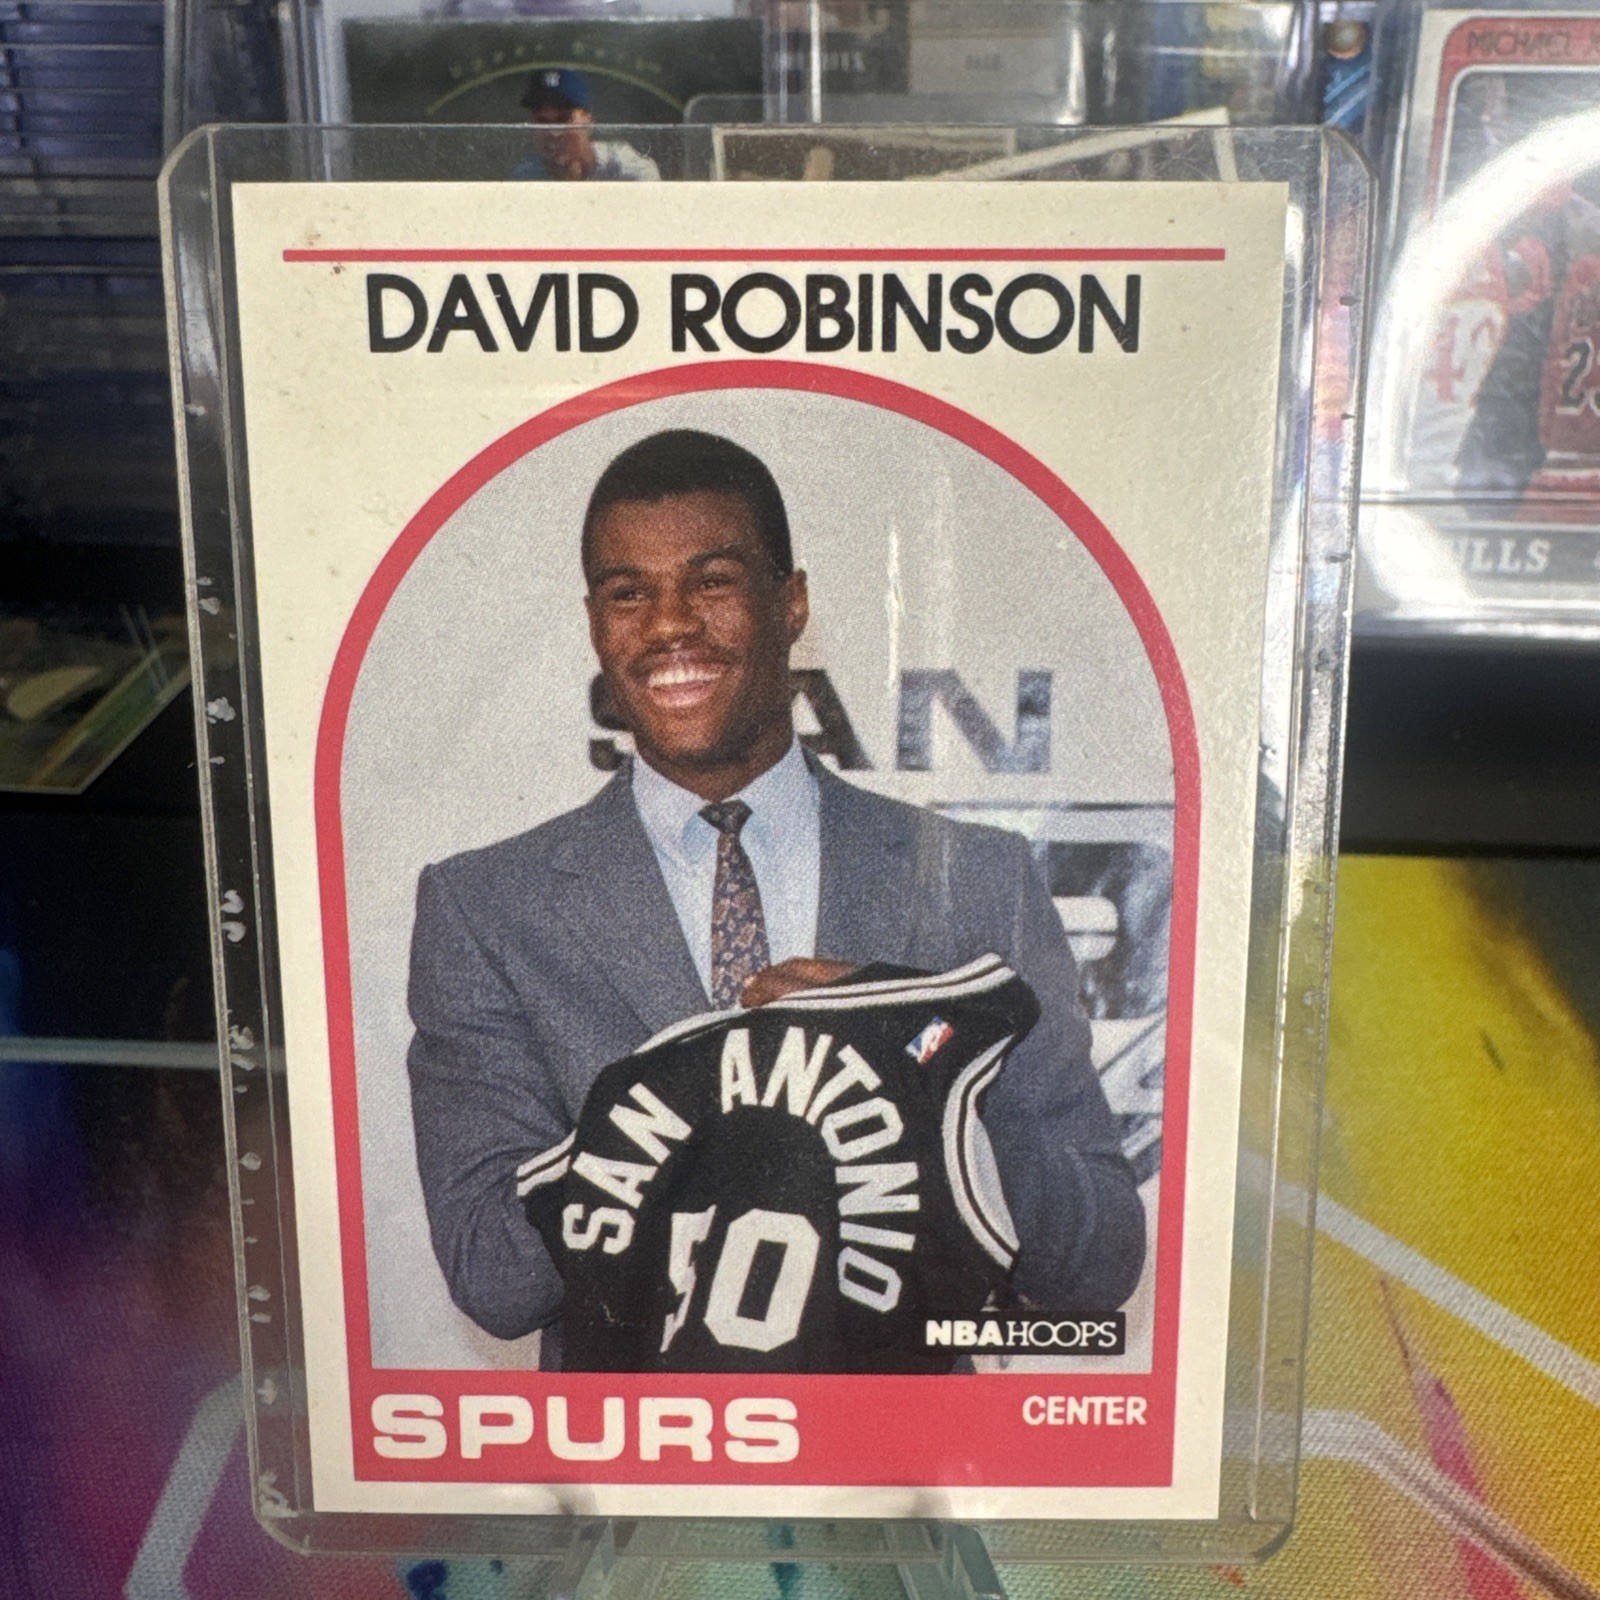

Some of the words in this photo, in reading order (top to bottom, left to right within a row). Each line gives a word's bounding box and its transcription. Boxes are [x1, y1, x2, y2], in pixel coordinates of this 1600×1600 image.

[366, 272, 639, 353] DAVID
[671, 272, 1141, 354] ROBINSON
[562, 1082, 692, 1255] SAN
[720, 1026, 921, 1313] ANTONIO
[371, 1393, 800, 1463] SPURS
[1022, 1394, 1148, 1426] CENTER
